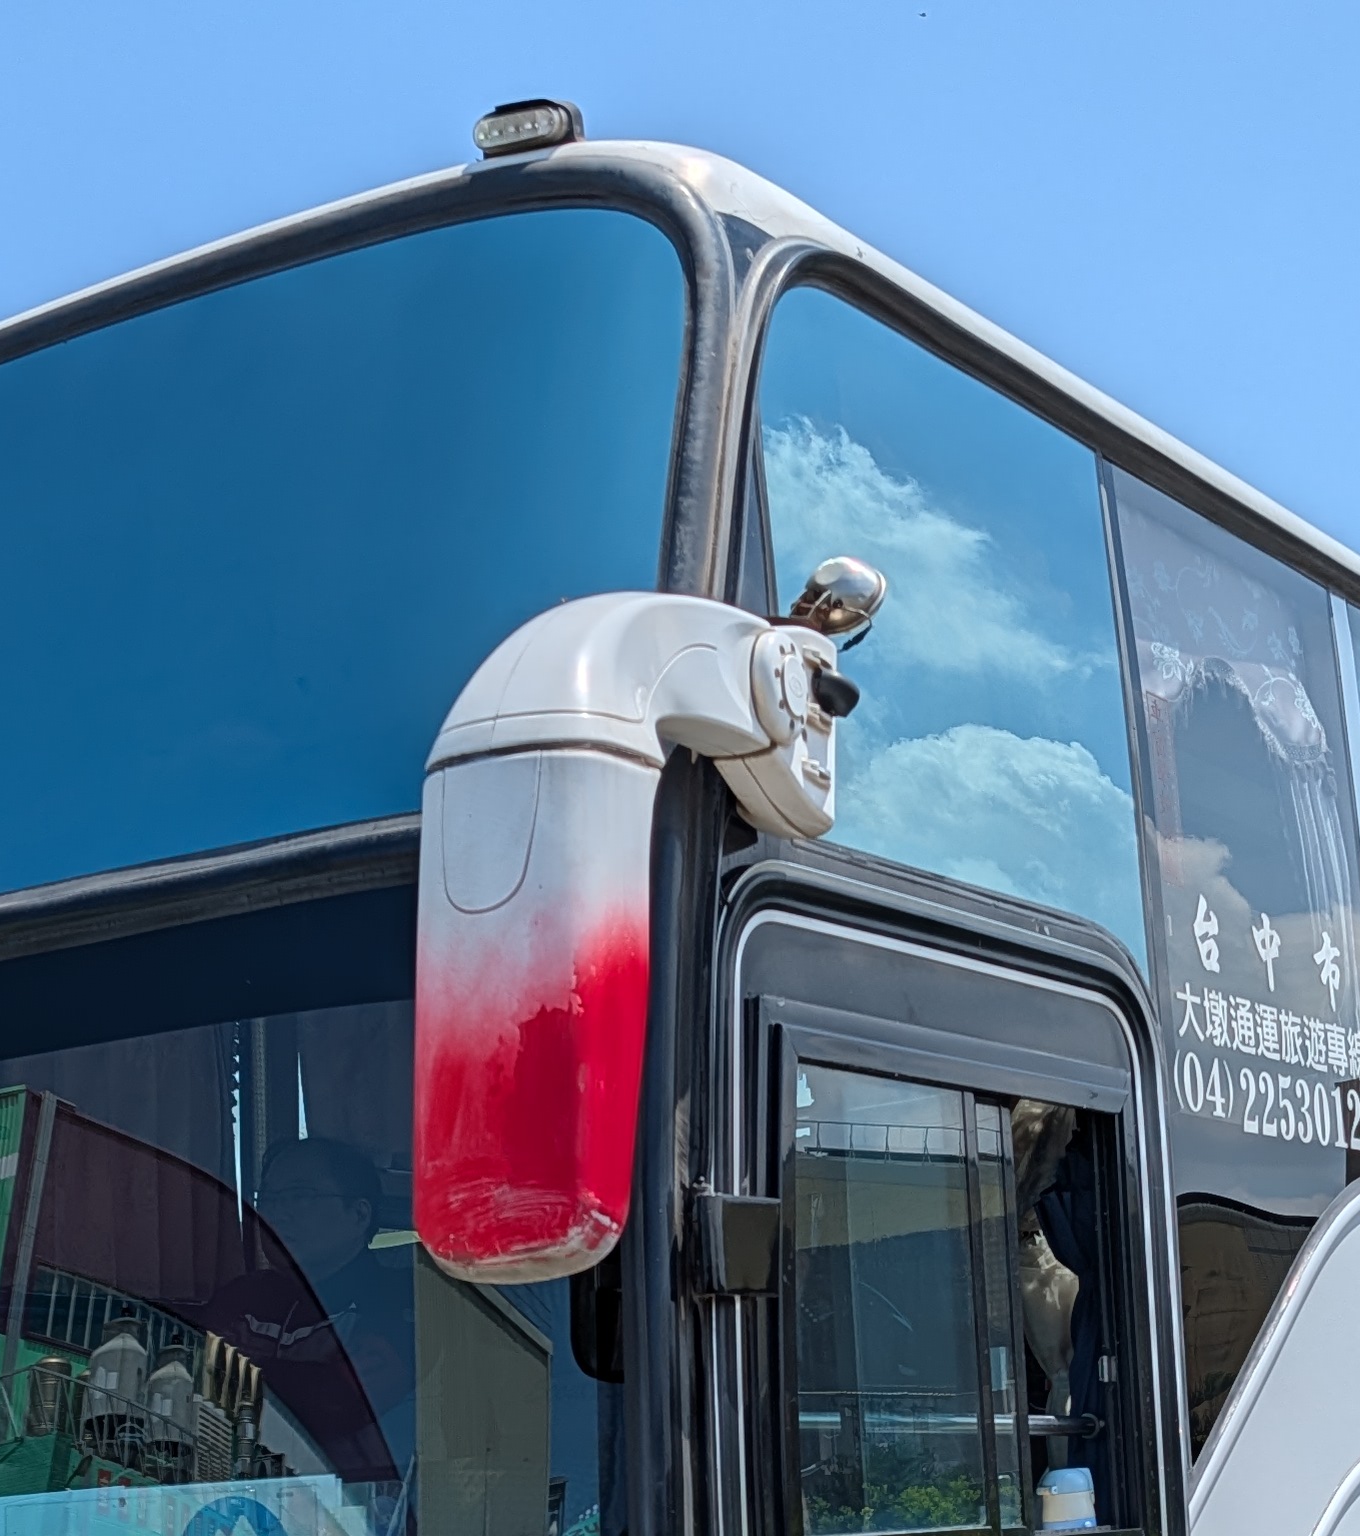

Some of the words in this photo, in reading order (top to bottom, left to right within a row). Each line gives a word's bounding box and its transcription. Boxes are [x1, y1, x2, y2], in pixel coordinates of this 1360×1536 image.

[1193, 893, 1341, 1012] 台中市
[1173, 1049, 1234, 1119] (04)
